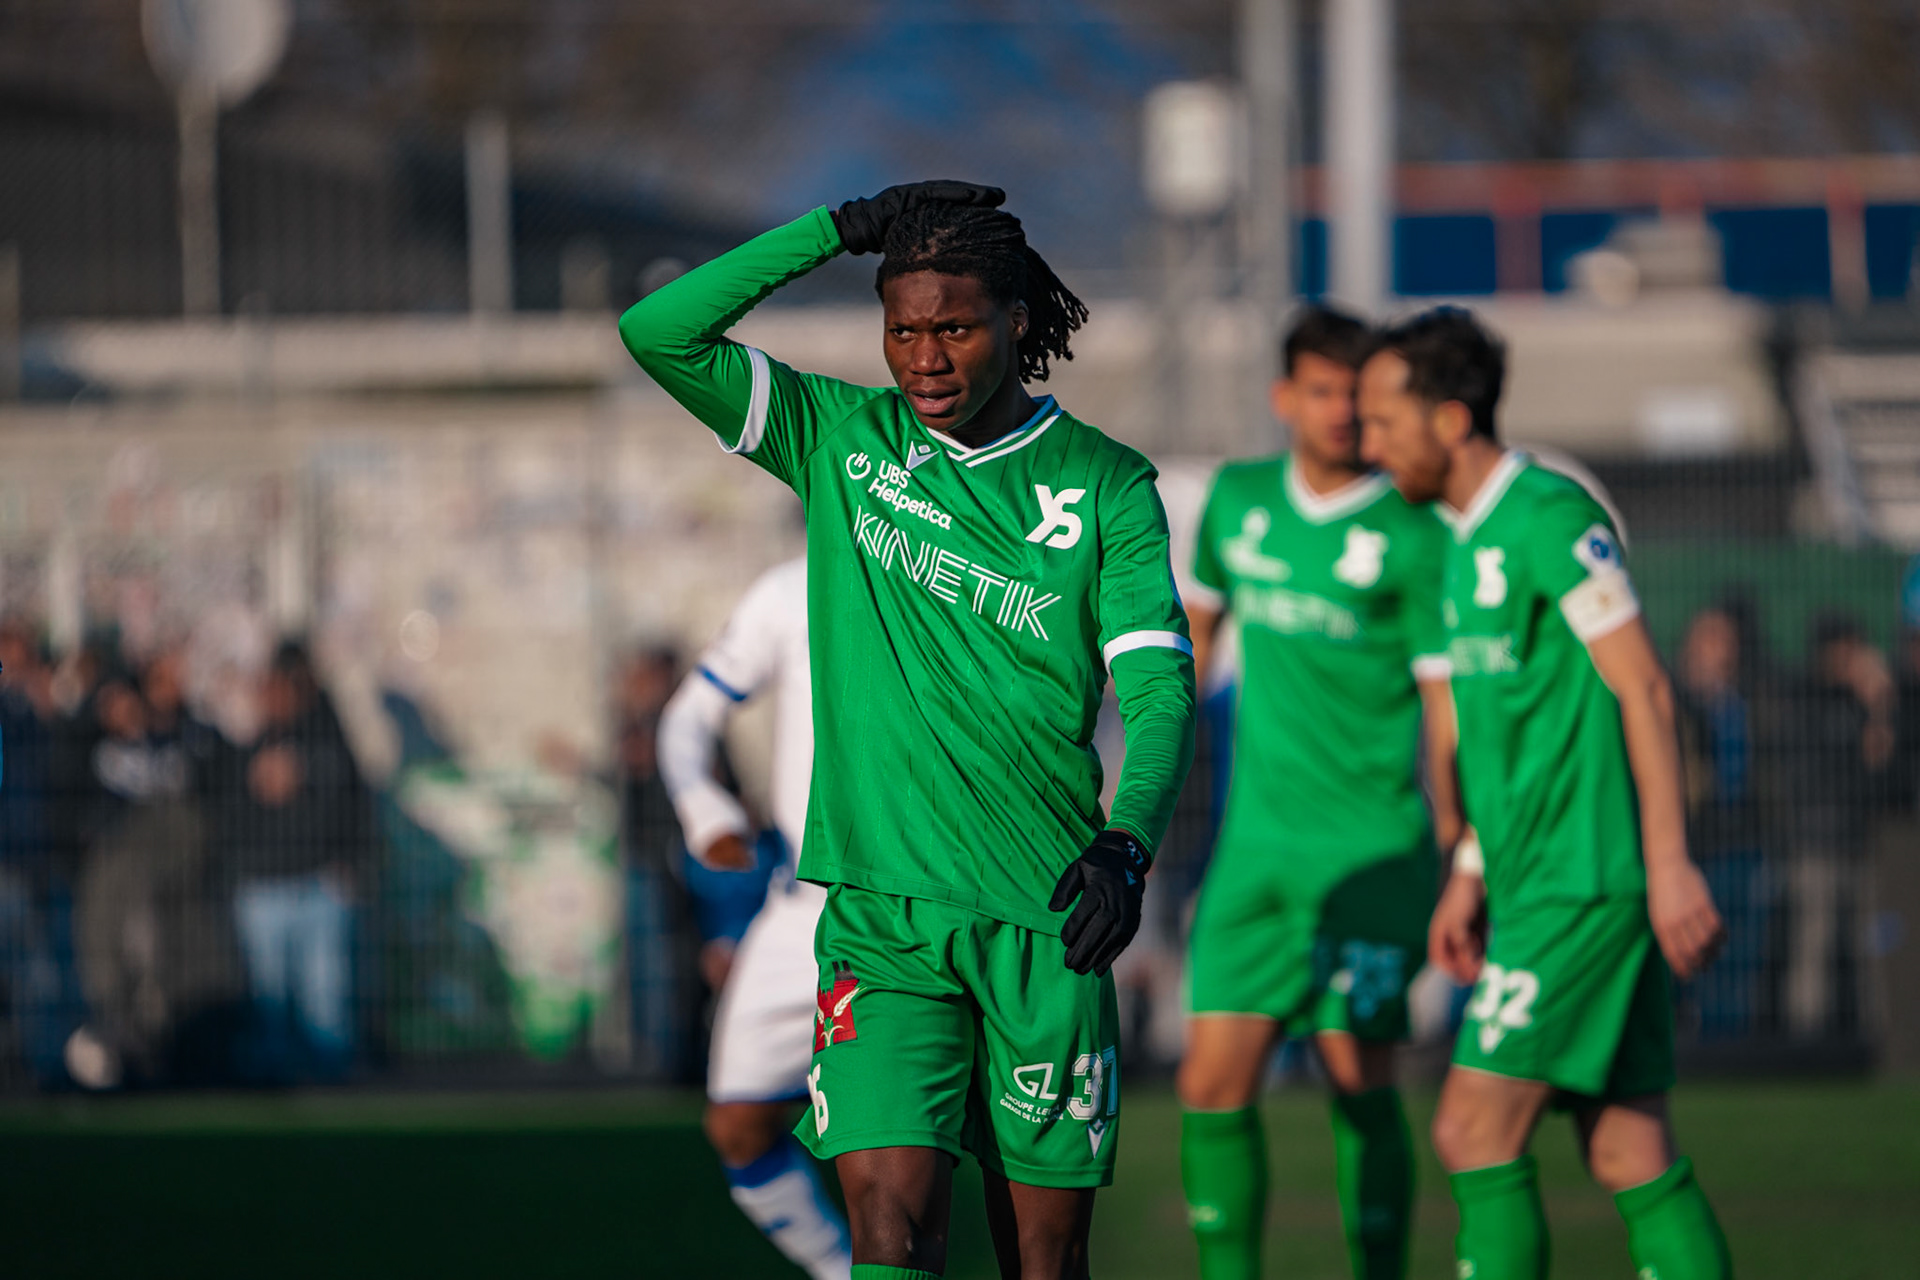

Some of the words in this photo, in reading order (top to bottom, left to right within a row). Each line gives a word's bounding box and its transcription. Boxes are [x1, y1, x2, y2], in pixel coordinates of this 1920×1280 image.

[878, 459, 912, 489] UBS
[867, 477, 953, 530] Helpetica
[1025, 484, 1087, 550] YS
[853, 505, 1062, 641] KINETIK
[1005, 1092, 1034, 1112] GROUPE
[1021, 1111, 1032, 1121] DE
[1031, 1115, 1042, 1124] LA
